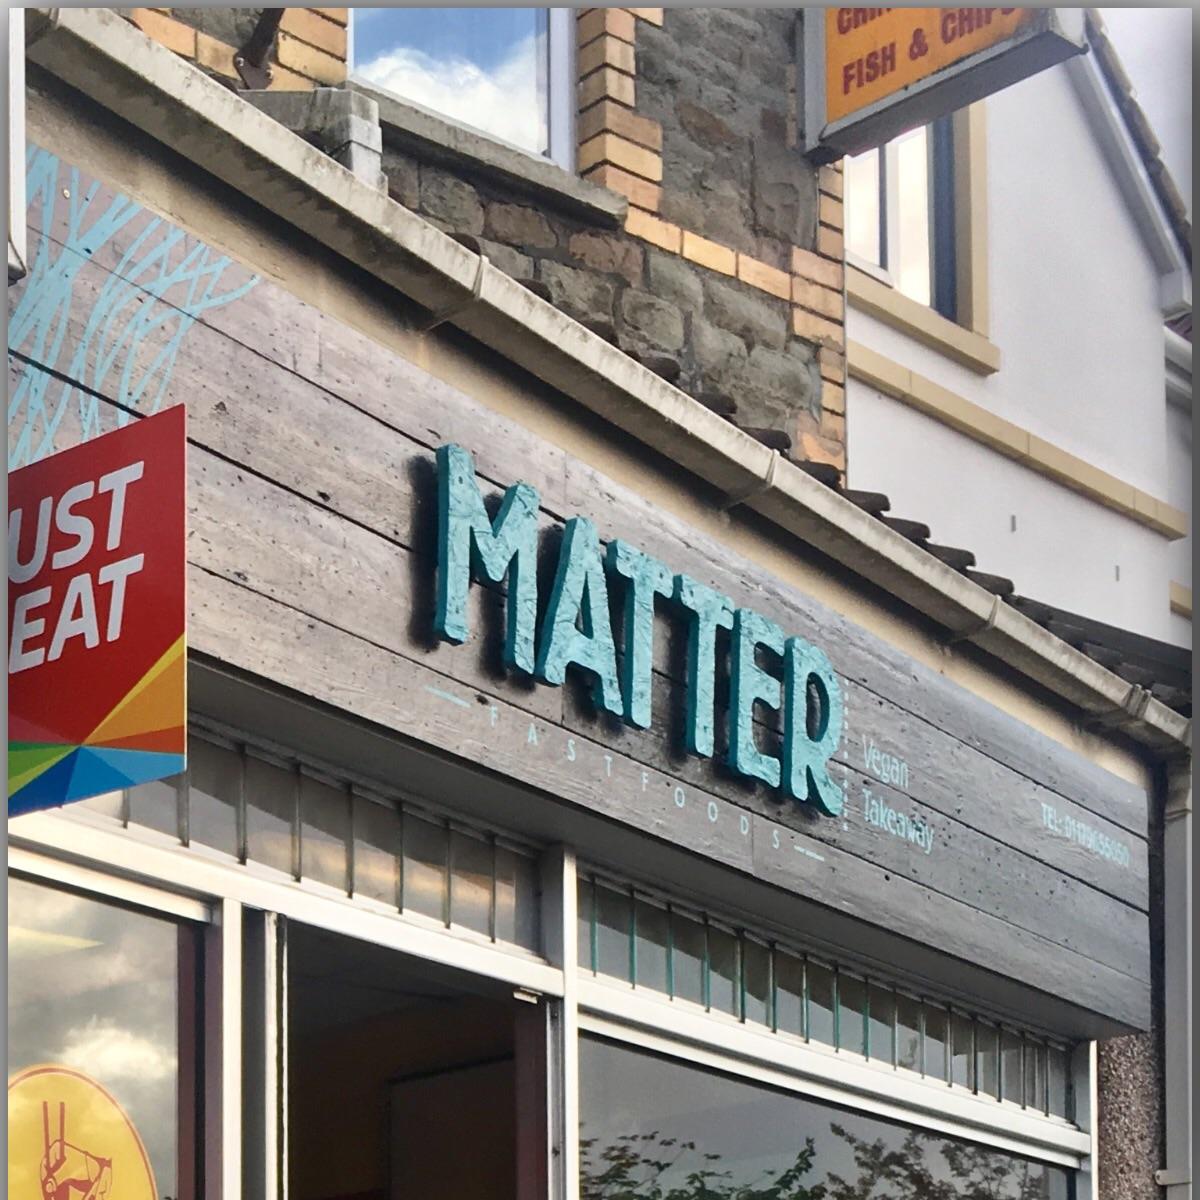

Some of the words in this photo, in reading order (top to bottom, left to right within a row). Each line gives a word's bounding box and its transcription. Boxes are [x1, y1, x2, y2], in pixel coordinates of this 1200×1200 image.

[843, 41, 896, 95] FISH
[908, 28, 929, 61] &
[941, 8, 1015, 44] CHIP
[8, 553, 145, 674] EAT
[435, 443, 843, 818] MATTER
[862, 734, 909, 789] Vegan
[862, 788, 935, 855] Takeaway
